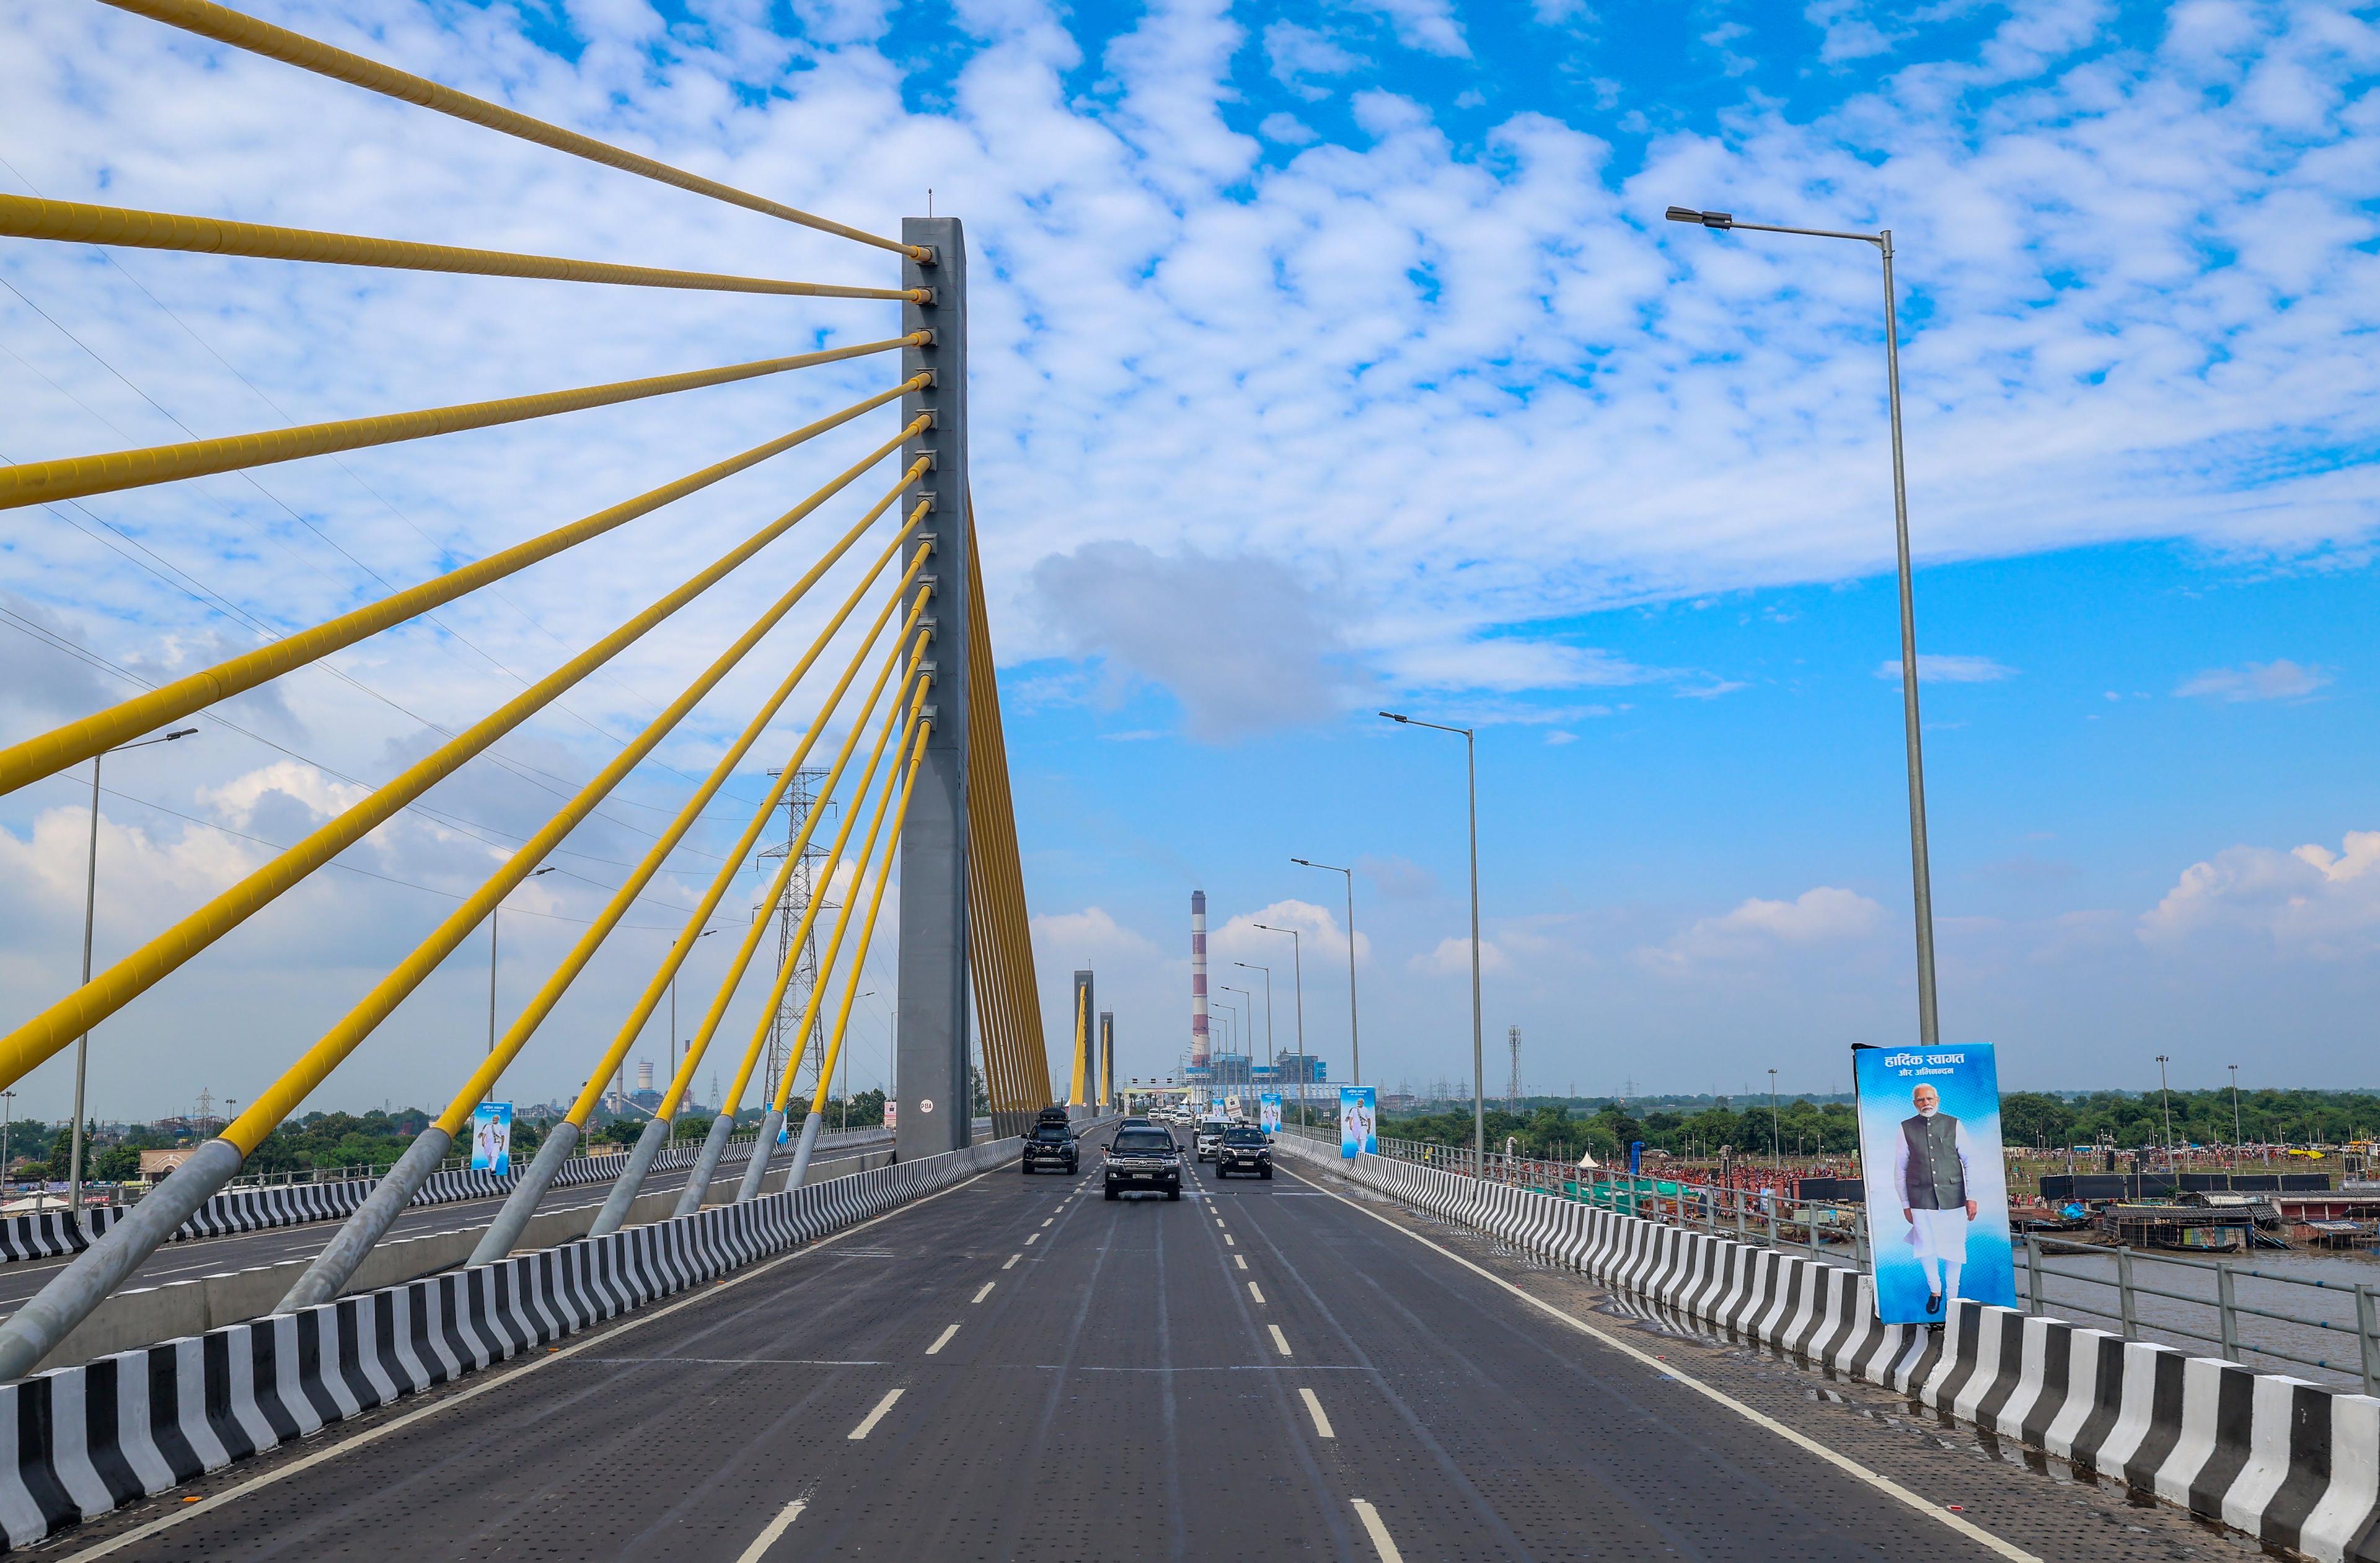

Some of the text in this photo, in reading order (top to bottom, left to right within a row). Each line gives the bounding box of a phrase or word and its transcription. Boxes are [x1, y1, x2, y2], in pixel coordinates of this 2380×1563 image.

[1884, 1053, 1965, 1067] हार्दिक स्वागत
[1898, 1067, 1954, 1076] और अभिनन्दन
